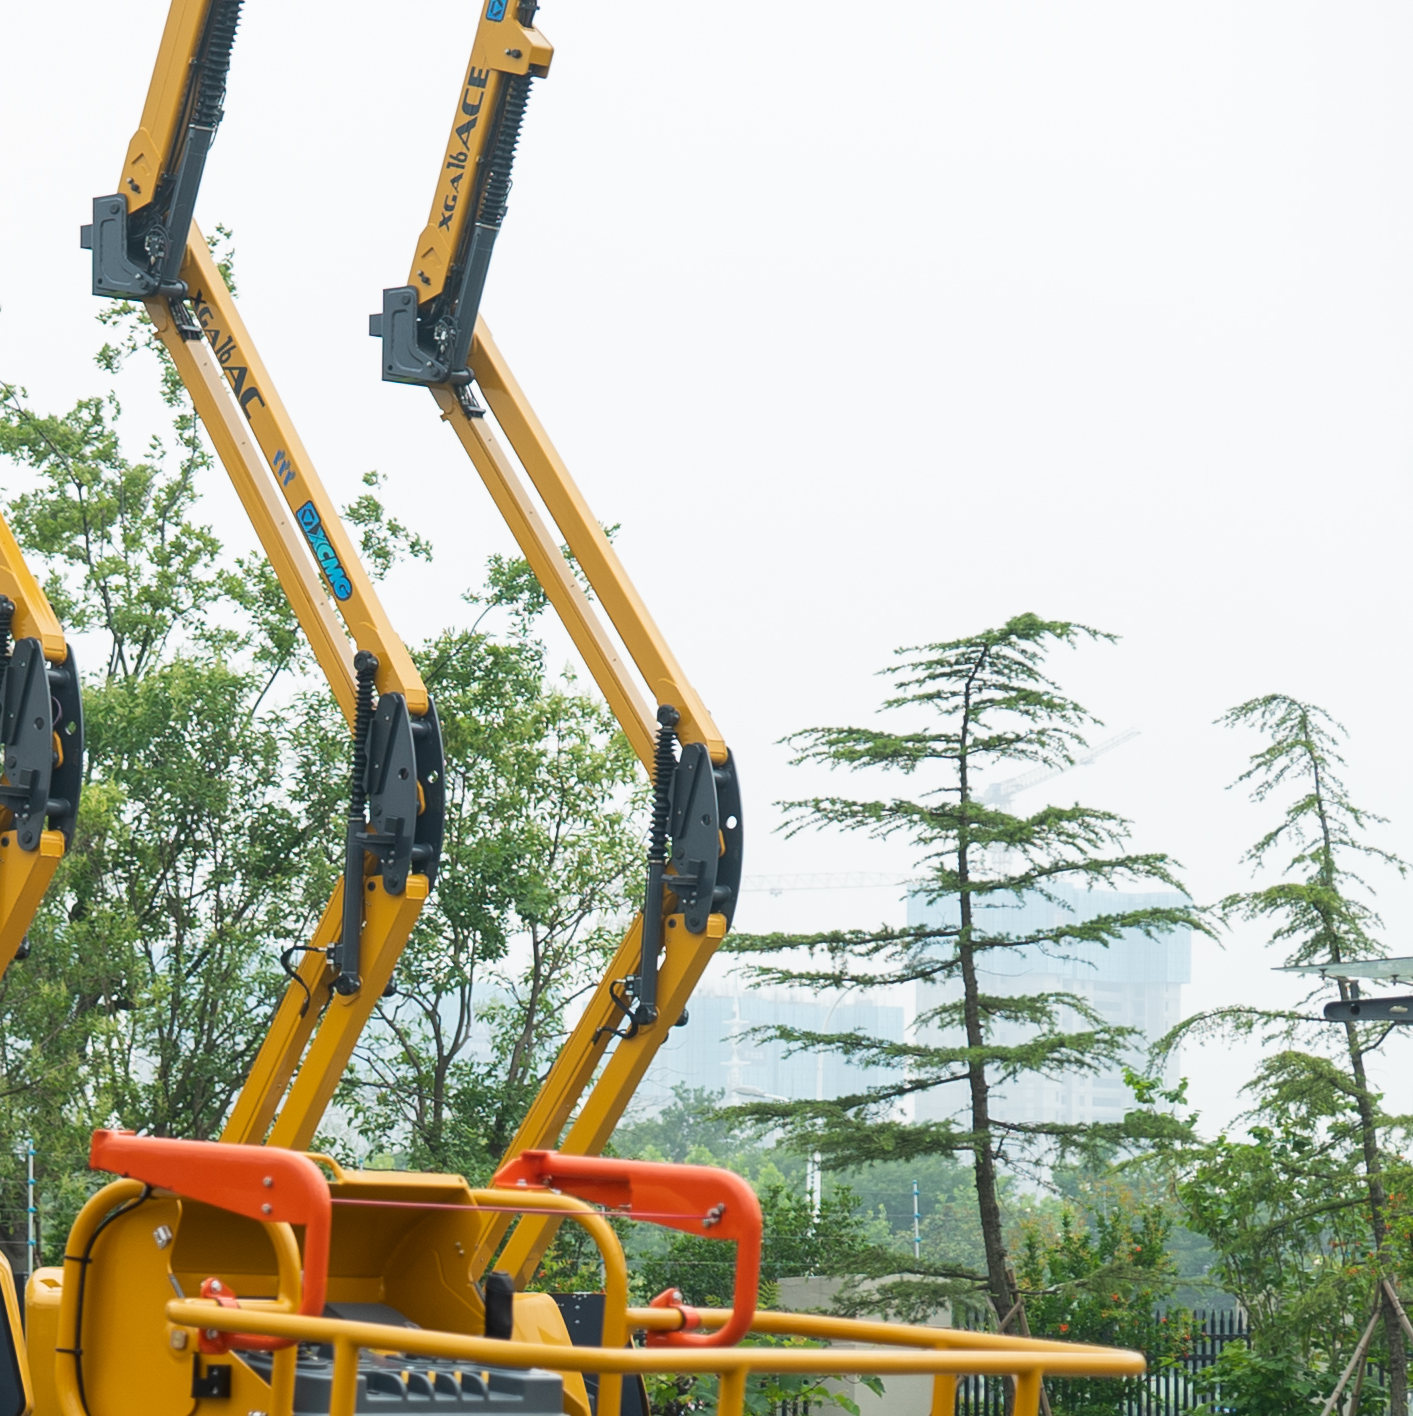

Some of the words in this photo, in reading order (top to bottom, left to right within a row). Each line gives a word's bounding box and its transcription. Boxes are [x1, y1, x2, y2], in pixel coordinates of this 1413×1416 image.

[439, 66, 490, 232] XGA16ACE
[189, 289, 266, 420] XGA16AC
[307, 525, 351, 599] XCMG
